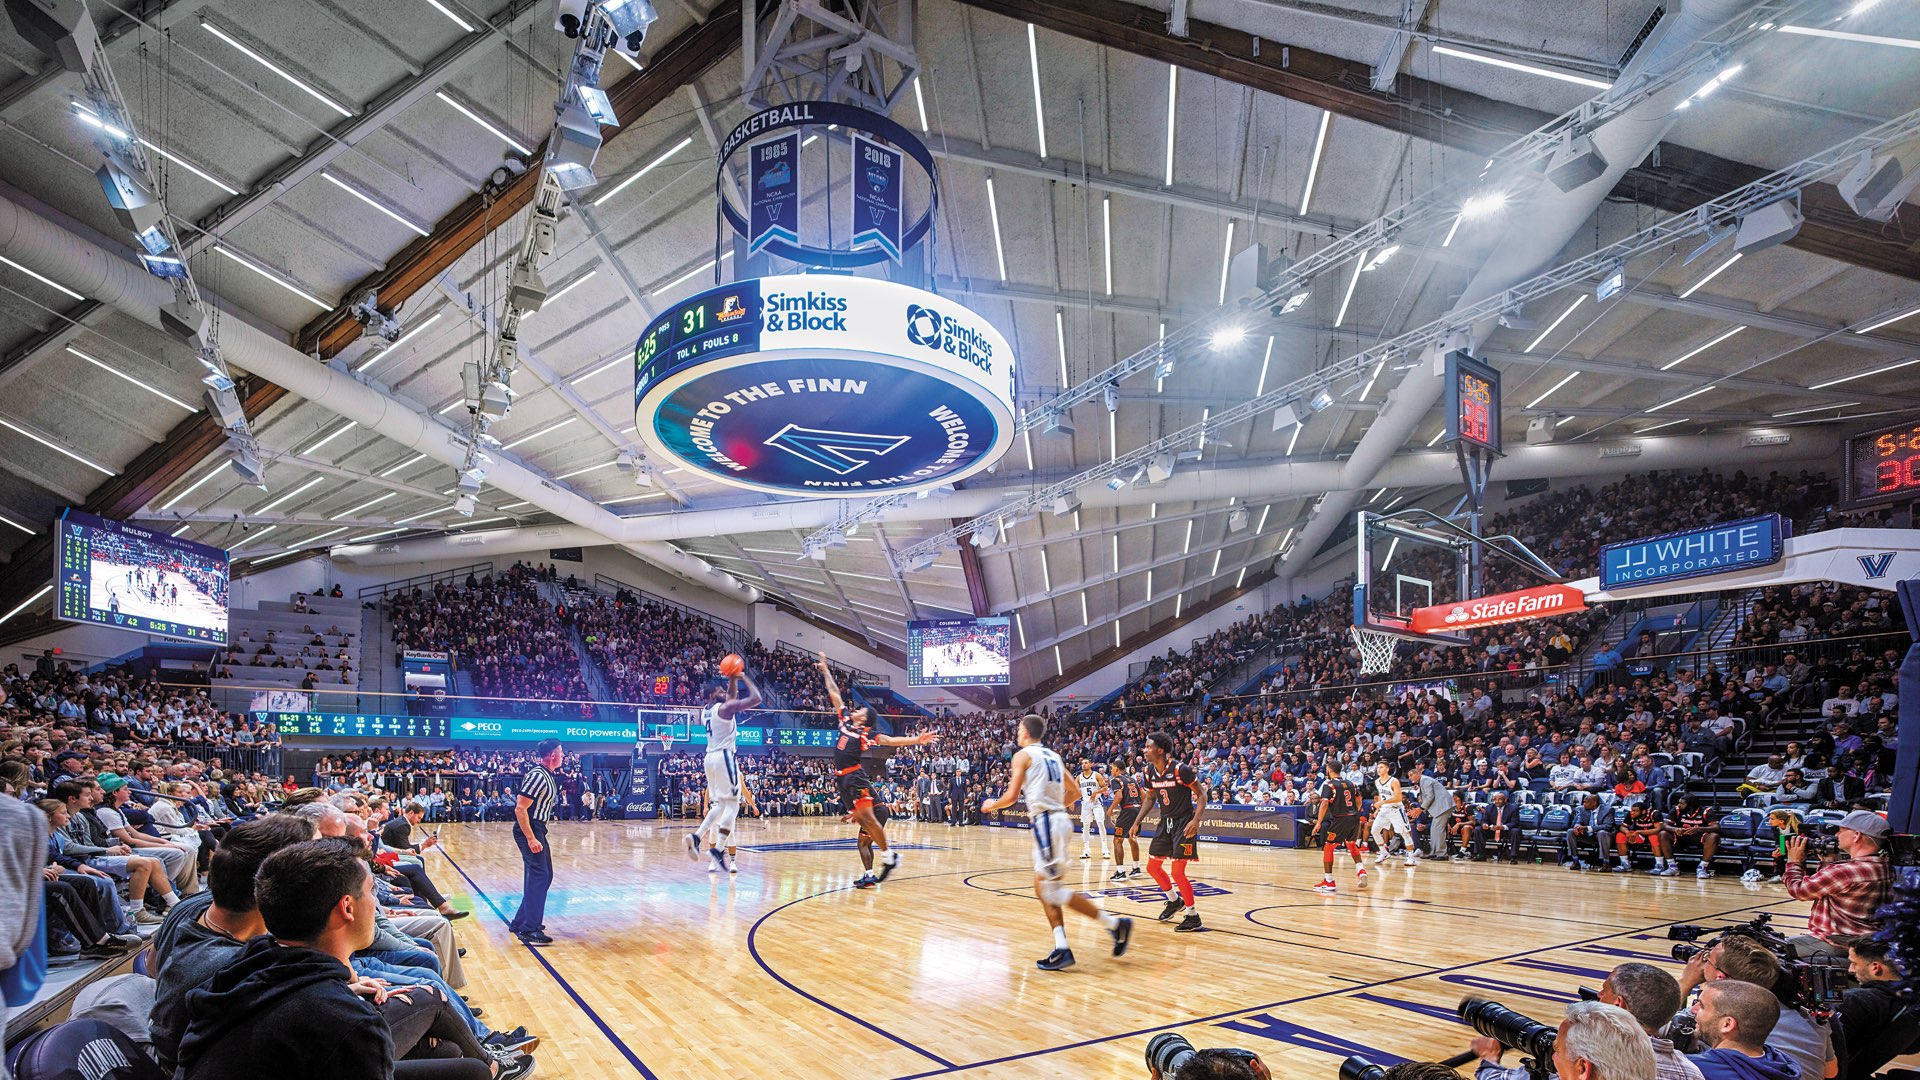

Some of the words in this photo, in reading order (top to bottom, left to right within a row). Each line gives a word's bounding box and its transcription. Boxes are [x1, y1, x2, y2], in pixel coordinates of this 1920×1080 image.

[724, 105, 813, 154] BASKETBALL
[761, 142, 788, 162] 1985
[865, 146, 891, 168] 2018
[767, 190, 782, 198] NCAA
[870, 194, 884, 203] NCAA
[767, 292, 847, 312] Simkiss
[659, 322, 670, 334] POSS
[684, 306, 704, 334] 31
[767, 315, 784, 332] &
[787, 312, 847, 331] Block
[943, 316, 993, 357] Simkiss
[677, 350, 689, 360] TOL
[692, 345, 697, 354] 4
[703, 336, 729, 350] FOULS
[733, 334, 739, 342] 8
[944, 336, 956, 356] &
[959, 344, 992, 376] Block
[724, 382, 785, 406] THE
[788, 379, 867, 394] FINN
[702, 402, 731, 420] TO
[1464, 399, 1488, 442] 30
[690, 418, 747, 471] WELCOME
[929, 405, 970, 464] WELCOME
[867, 475, 916, 486] THE
[918, 466, 945, 476] TO
[122, 526, 152, 539] MULROY
[1617, 547, 1647, 569] JJ
[1656, 525, 1758, 561] WHITE
[1616, 550, 1759, 582] INCORPORATED
[1856, 552, 1898, 580] V
[1471, 602, 1516, 620] State
[1517, 593, 1564, 613] Farm
[128, 618, 138, 626] 42
[150, 622, 167, 631] 5:25
[188, 628, 196, 636] 31
[654, 683, 668, 694] 22
[567, 728, 588, 736] PECO
[590, 730, 621, 738] powers
[706, 720, 713, 737] 4
[1087, 788, 1092, 797] 5
[1160, 789, 1170, 806] 3
[1344, 790, 1352, 807] 2
[1211, 820, 1244, 828] Villanova
[1244, 822, 1280, 830] Athletics.
